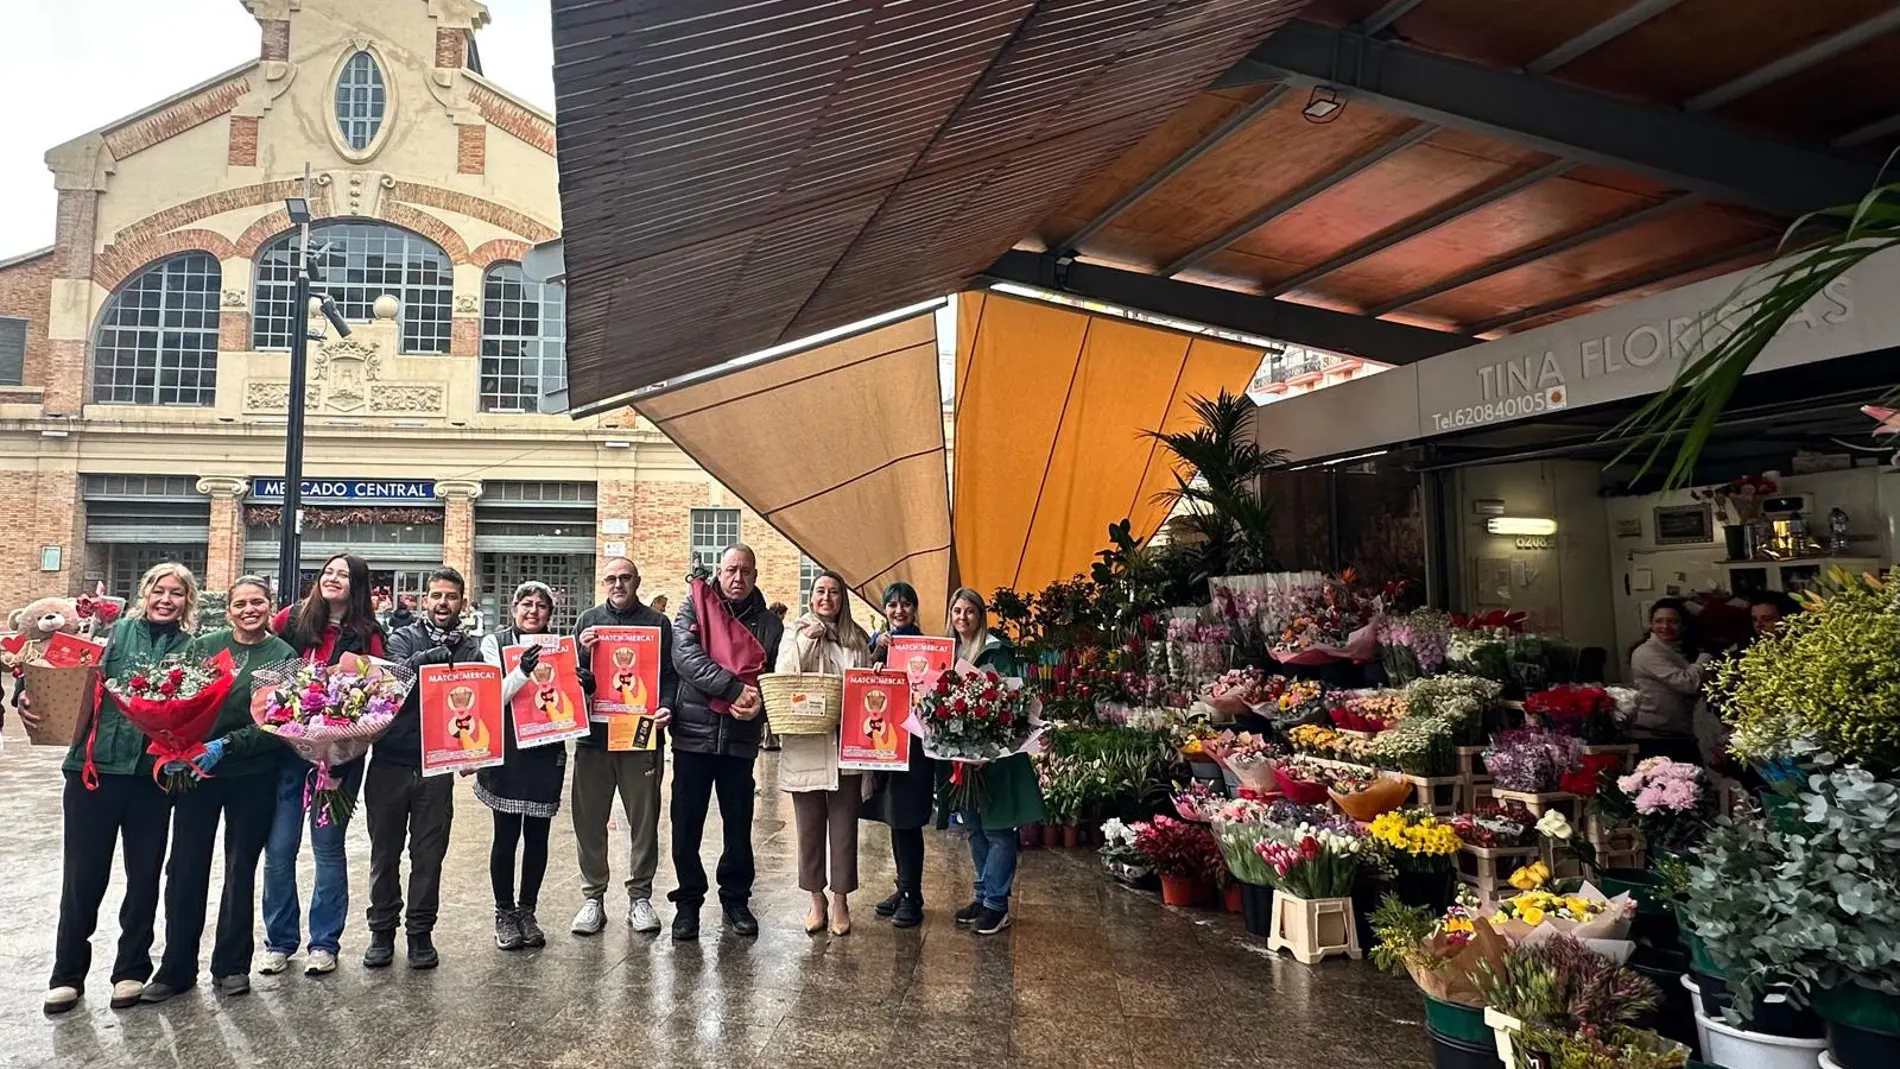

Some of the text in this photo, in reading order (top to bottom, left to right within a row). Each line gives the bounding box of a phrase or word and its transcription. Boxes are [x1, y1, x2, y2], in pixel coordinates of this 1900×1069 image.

[1476, 276, 1855, 401] TINA FLORISAS
[1432, 392, 1545, 431] Tel.620840105
[264, 481, 426, 497] MECADO CENTRAL
[428, 671, 495, 683] MATCH MERCAT
[850, 676, 905, 685] MATCH MERCAT
